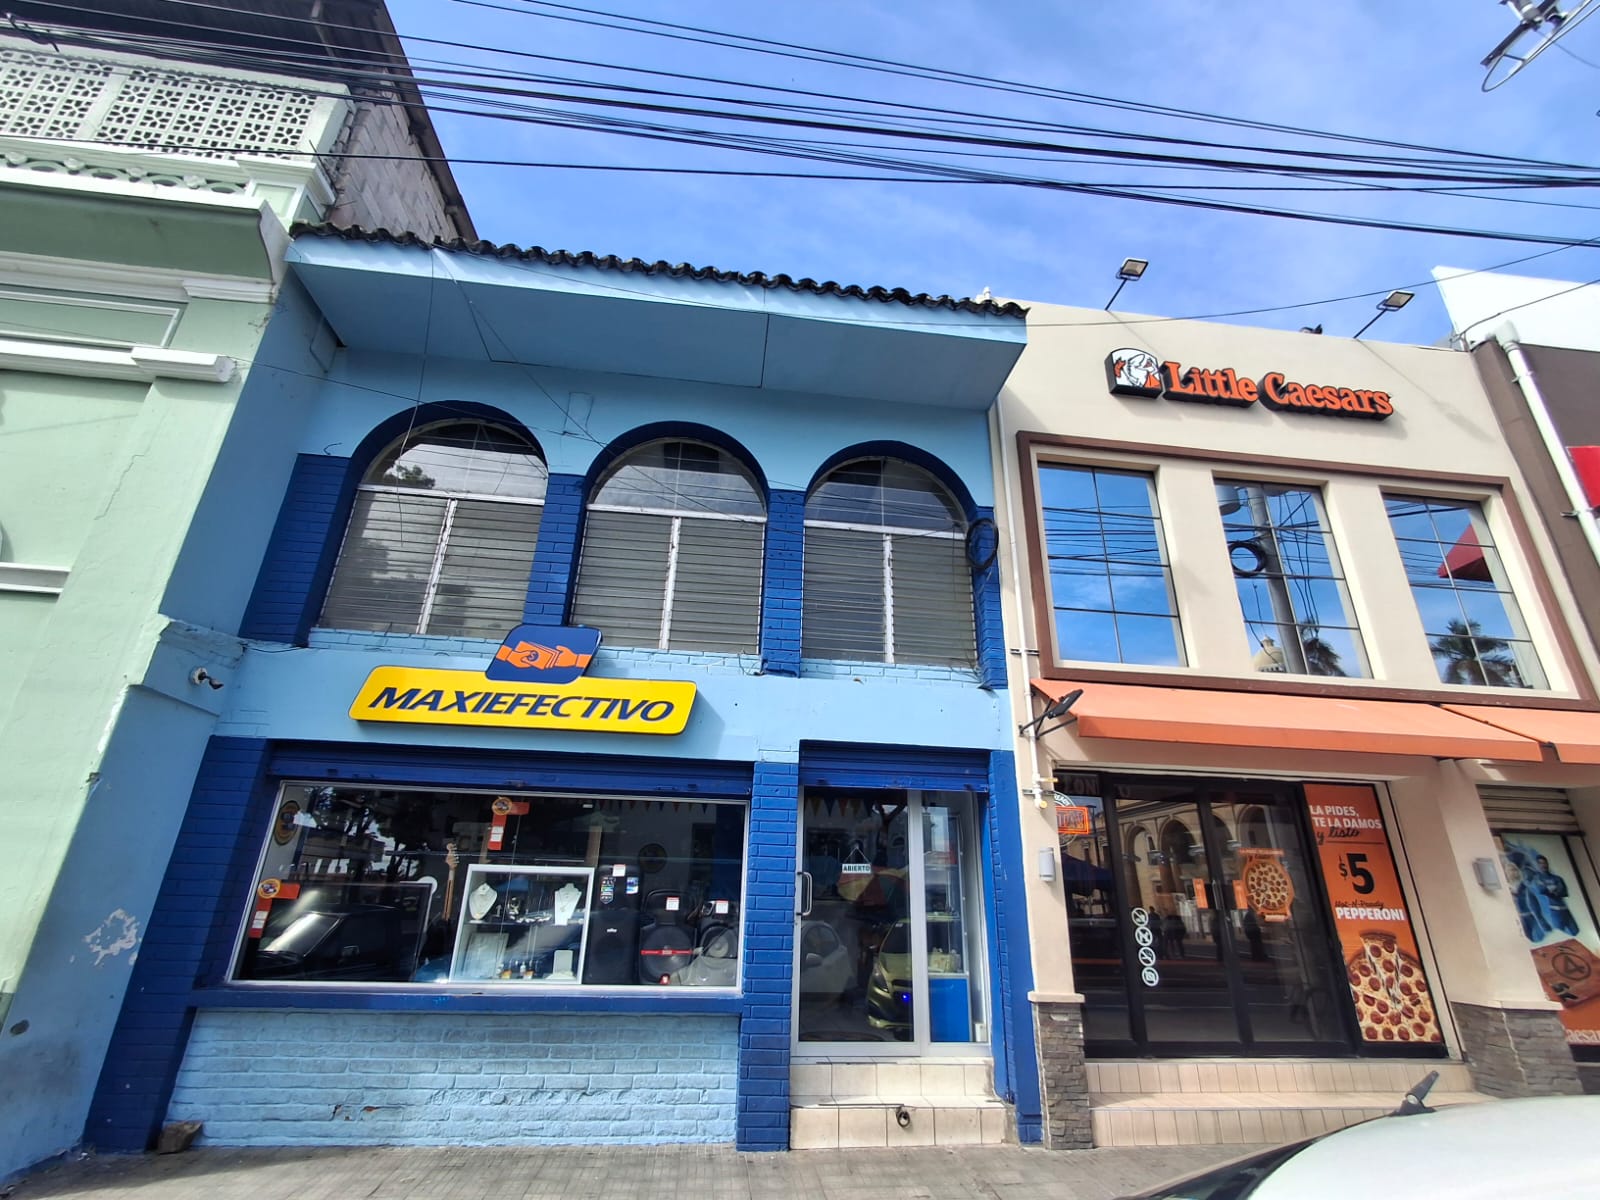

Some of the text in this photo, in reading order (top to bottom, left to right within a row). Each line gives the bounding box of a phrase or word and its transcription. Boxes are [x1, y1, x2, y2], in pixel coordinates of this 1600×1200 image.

[1161, 361, 1394, 417] Little Caesars
[368, 686, 675, 722] MAXIEFECTIVO
[1309, 805, 1360, 817] LA PIDES,
[1312, 817, 1382, 829] TE LA DAMOS
[842, 864, 870, 872] ABIERTO
[1335, 907, 1405, 920] PEPPERONI
